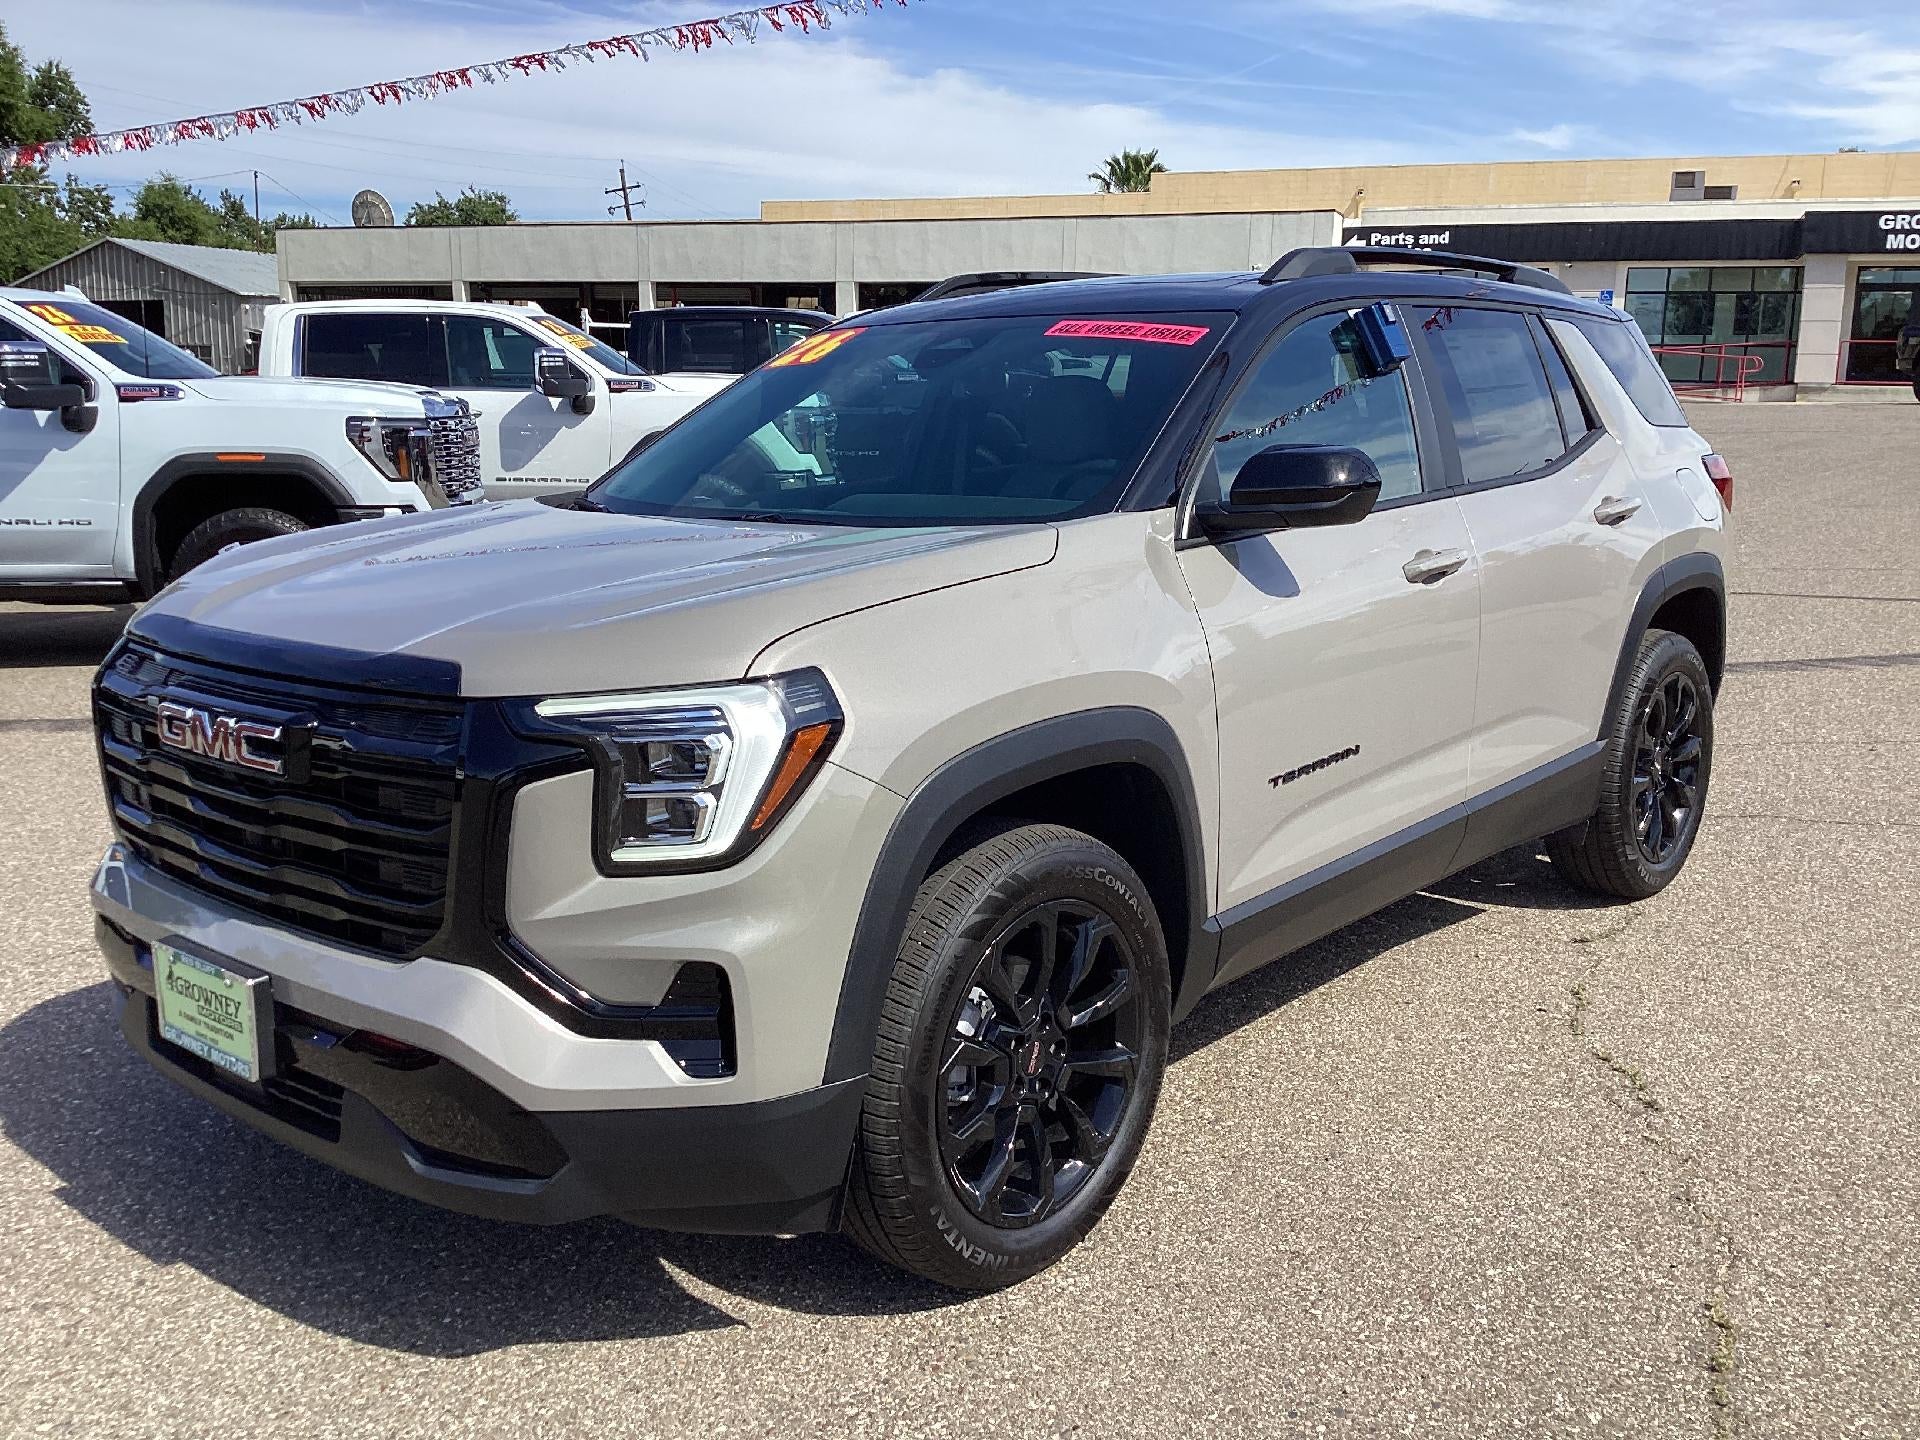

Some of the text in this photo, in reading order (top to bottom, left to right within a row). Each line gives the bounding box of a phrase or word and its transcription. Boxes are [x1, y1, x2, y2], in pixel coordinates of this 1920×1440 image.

[1370, 231, 1450, 246] Parts and
[1886, 234, 1920, 250] MO
[1051, 323, 1200, 343] ALL WHEEL DRIVE
[768, 330, 856, 368] 26
[58, 518, 92, 526] HD
[157, 701, 283, 775] GMC
[1267, 744, 1361, 790] TERRAIN
[175, 975, 242, 1019] GROWNEY
